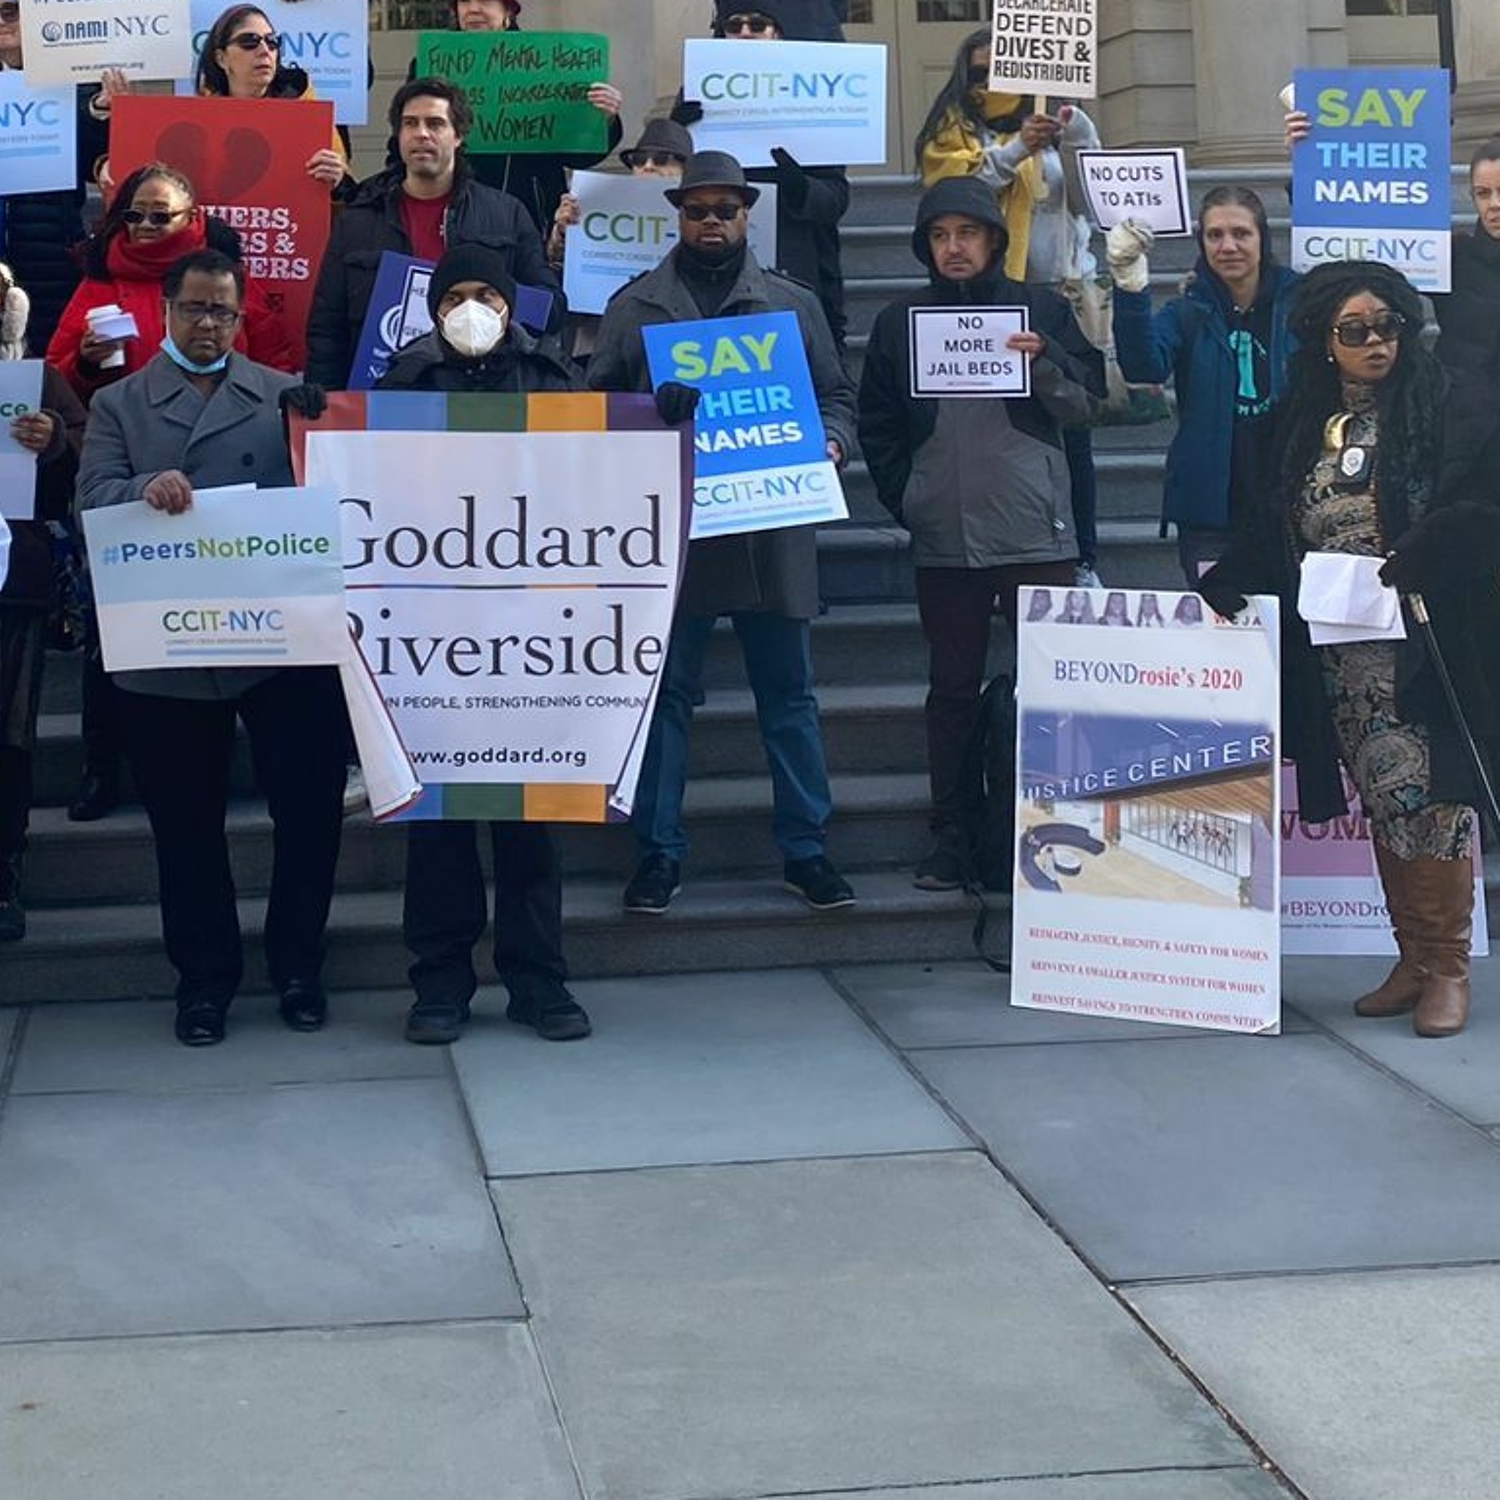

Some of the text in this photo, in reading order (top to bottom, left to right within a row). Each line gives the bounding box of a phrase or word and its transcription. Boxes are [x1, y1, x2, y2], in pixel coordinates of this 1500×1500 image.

[64, 15, 171, 40] NAMI NYC
[996, 12, 1093, 37] DEFEND
[428, 40, 603, 77] FUND MENTAL HEALTH
[995, 36, 1091, 63] DIVEST &
[993, 60, 1093, 84] REDISTRIBUTE
[701, 73, 870, 101] CCIT-NYC
[1316, 87, 1427, 128] SAY
[477, 107, 556, 143] WOMEN
[1315, 141, 1427, 170] THEIR
[1090, 165, 1164, 182] NO CUTS
[1100, 191, 1120, 207] TO
[1314, 179, 1430, 205] NAMES
[1304, 236, 1437, 262] CCIT-NYC
[957, 316, 985, 330] NO
[671, 331, 779, 381] SAY
[944, 338, 995, 353] MORE
[926, 361, 1014, 376] JAIL BEDS
[694, 384, 794, 420] HEIR
[340, 494, 667, 570] Goddard
[101, 533, 331, 566] #PeersNotPolice
[162, 608, 285, 633] CCIT-NYC
[1054, 658, 1243, 691] BEYONDrosie's 2020
[402, 696, 461, 711] PEOPLE,
[465, 695, 582, 710] STRENGTHENING
[411, 747, 587, 767] ww.goddard.org
[1127, 734, 1273, 783] CENTER
